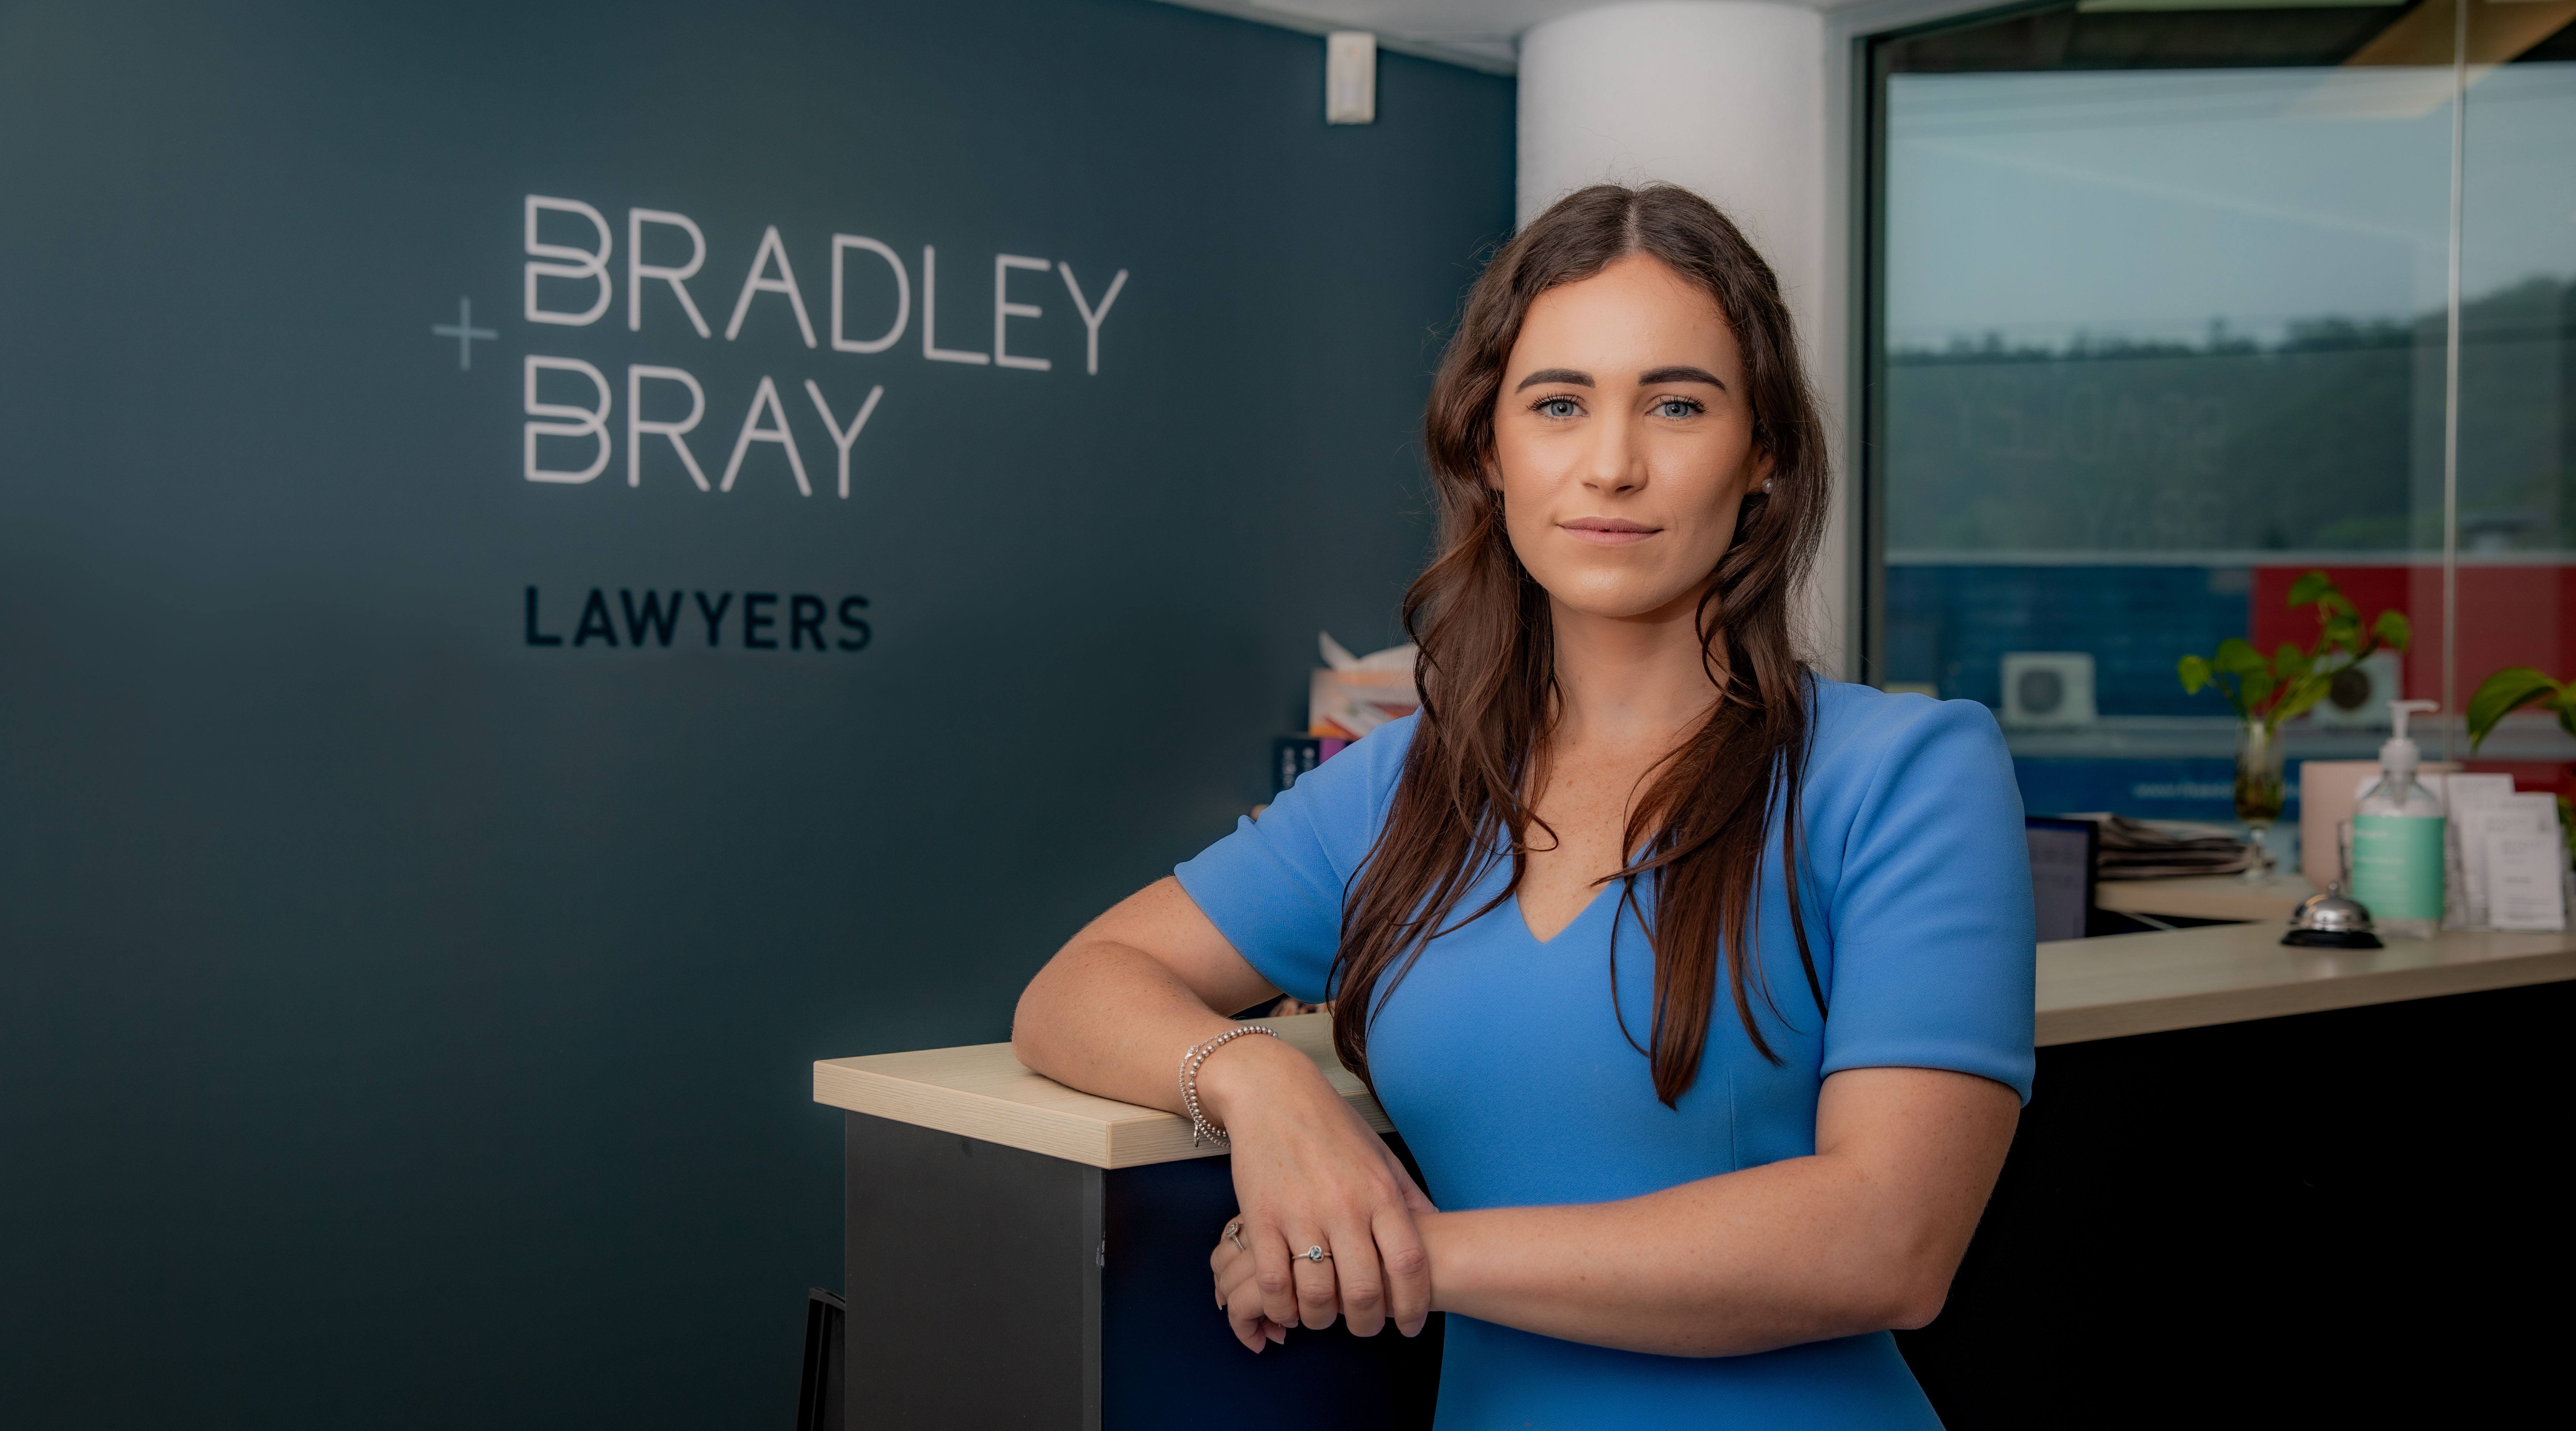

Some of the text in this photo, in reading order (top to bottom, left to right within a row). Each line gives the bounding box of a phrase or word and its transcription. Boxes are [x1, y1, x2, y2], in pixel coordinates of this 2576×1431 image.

[526, 195, 1127, 374] BRADLEY
[525, 356, 882, 498] BRAY
[526, 587, 870, 651] LAWYERS
